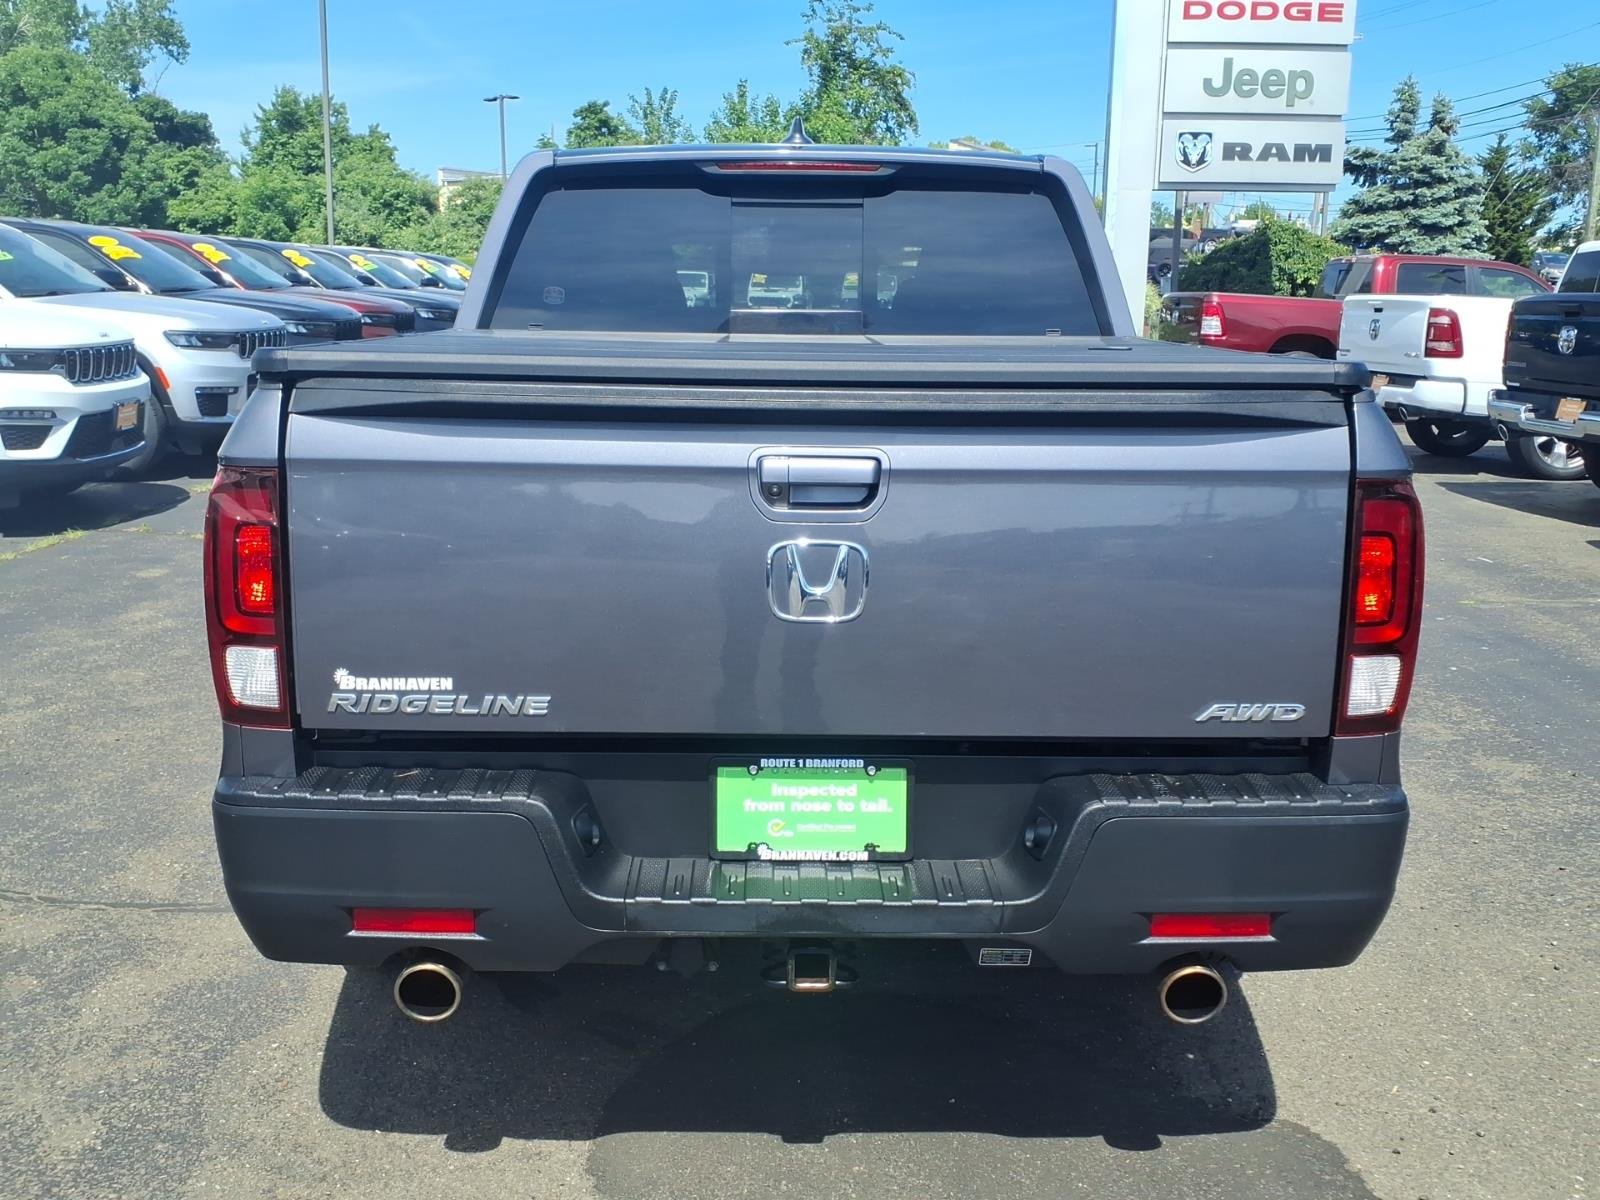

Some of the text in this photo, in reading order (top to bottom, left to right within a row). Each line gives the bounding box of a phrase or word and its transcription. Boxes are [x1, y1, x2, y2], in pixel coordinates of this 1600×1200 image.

[1183, 1, 1344, 22] DODGE
[1203, 57, 1314, 107] Jeep
[1222, 142, 1332, 163] RAM
[339, 674, 453, 691] BRANHAVEN
[327, 693, 552, 717] RIDGELINE
[1195, 703, 1306, 722] AWD
[760, 758, 864, 769] ROUTE 1 BRANFORD
[771, 783, 858, 798] Inspected
[743, 798, 893, 812] from nose to tail.
[760, 850, 869, 861] BRANHAVEN.COM
